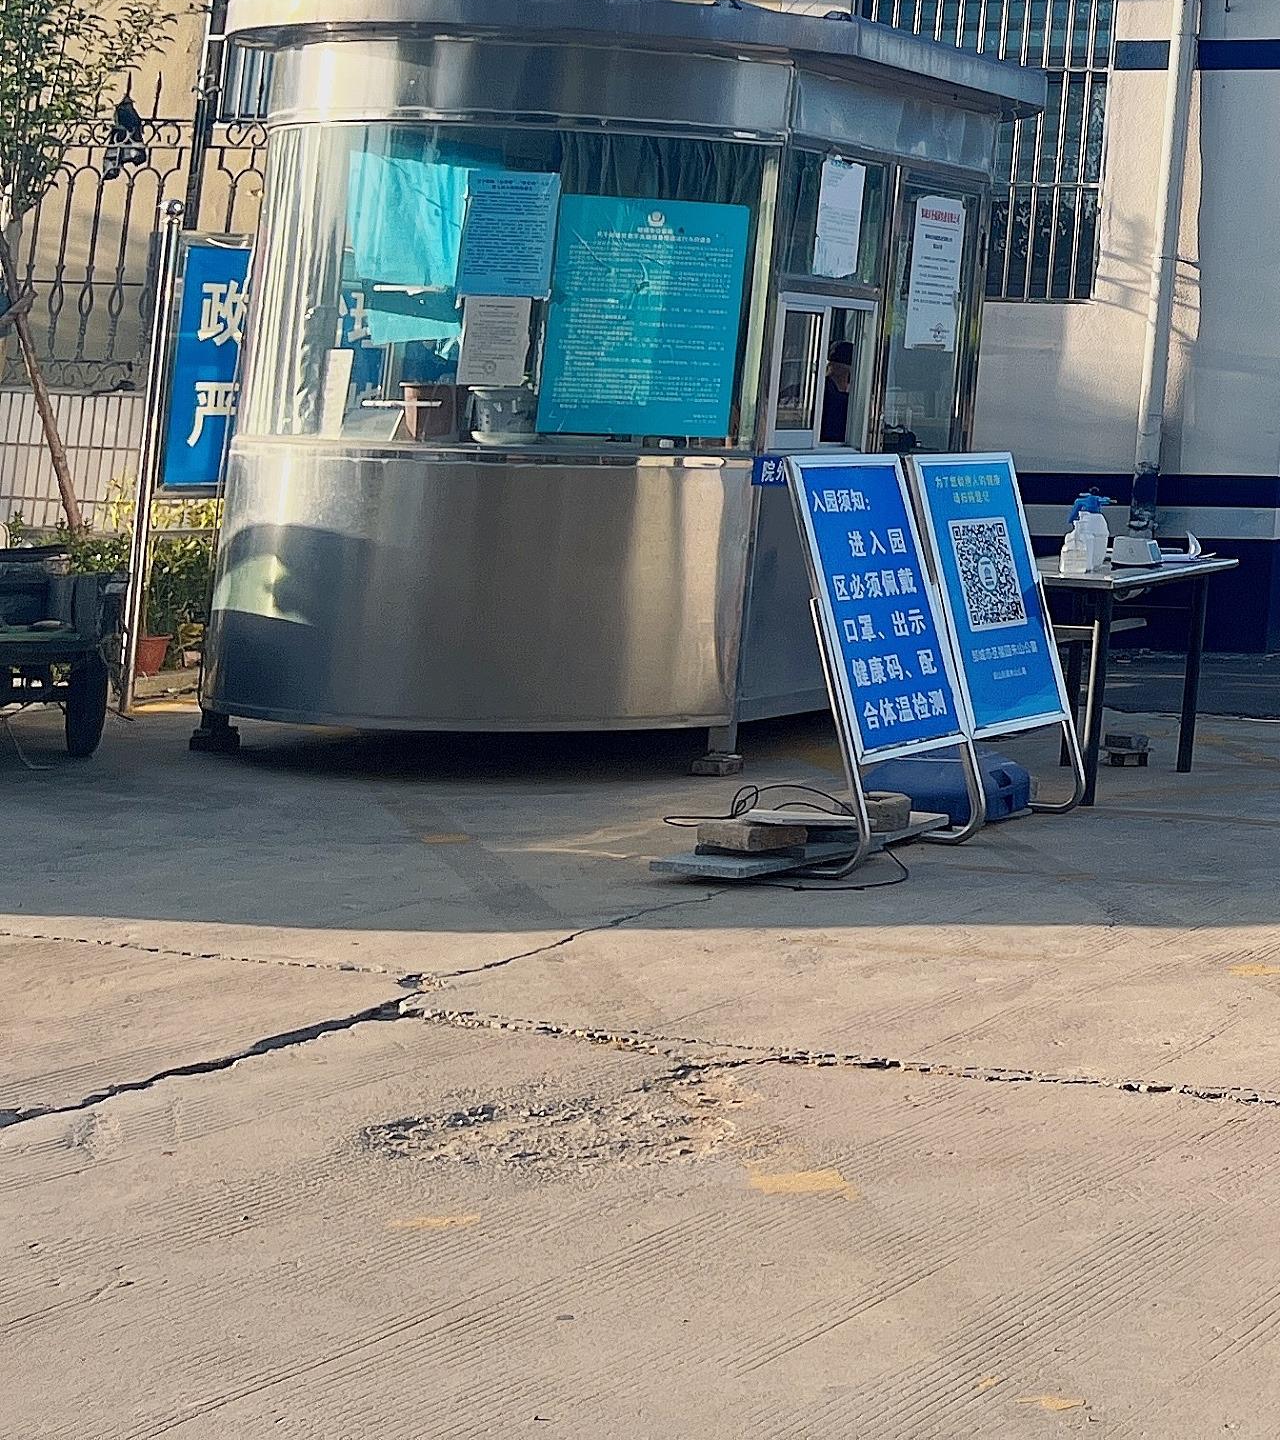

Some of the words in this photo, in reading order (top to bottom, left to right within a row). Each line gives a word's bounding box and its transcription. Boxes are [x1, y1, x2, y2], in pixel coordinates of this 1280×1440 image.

[848, 527, 908, 558] 进入园
[832, 568, 918, 602] 区必须佩戴
[843, 609, 926, 643] 口罩、出示
[851, 649, 938, 688] 健康码、配
[863, 689, 949, 731] 合体温检测
